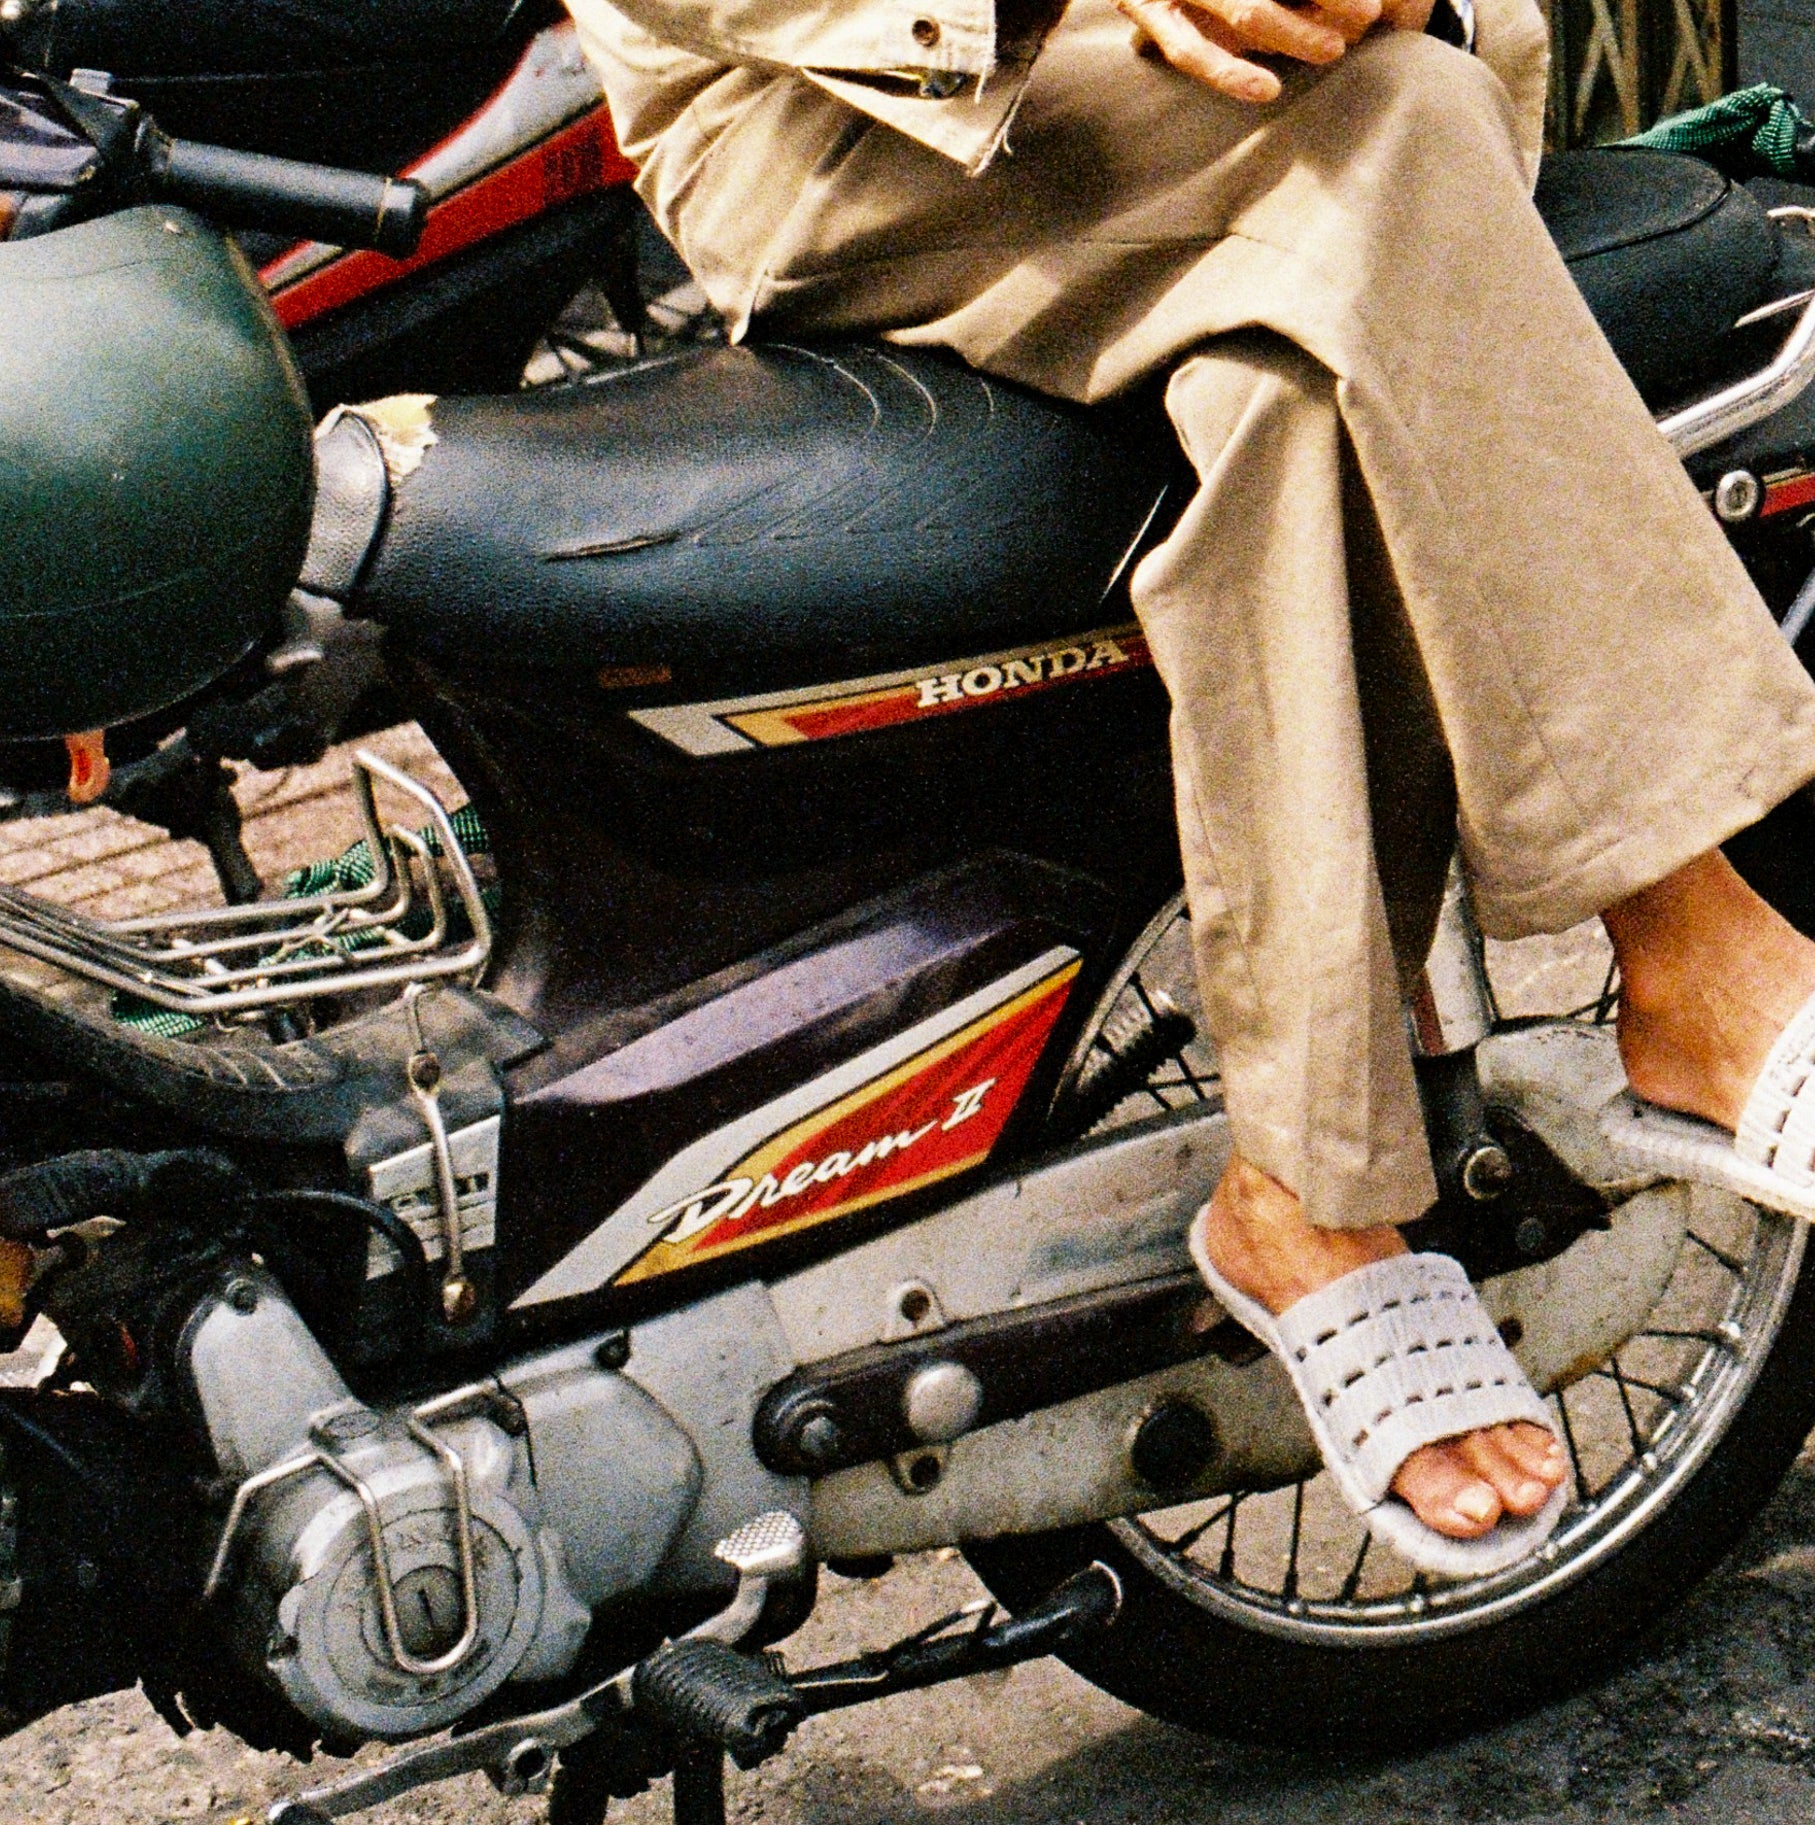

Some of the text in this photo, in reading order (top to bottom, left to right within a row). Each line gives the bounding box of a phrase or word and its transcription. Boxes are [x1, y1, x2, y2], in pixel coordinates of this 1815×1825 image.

[916, 639, 1129, 709] HONDA
[647, 1077, 996, 1243] Dream II
